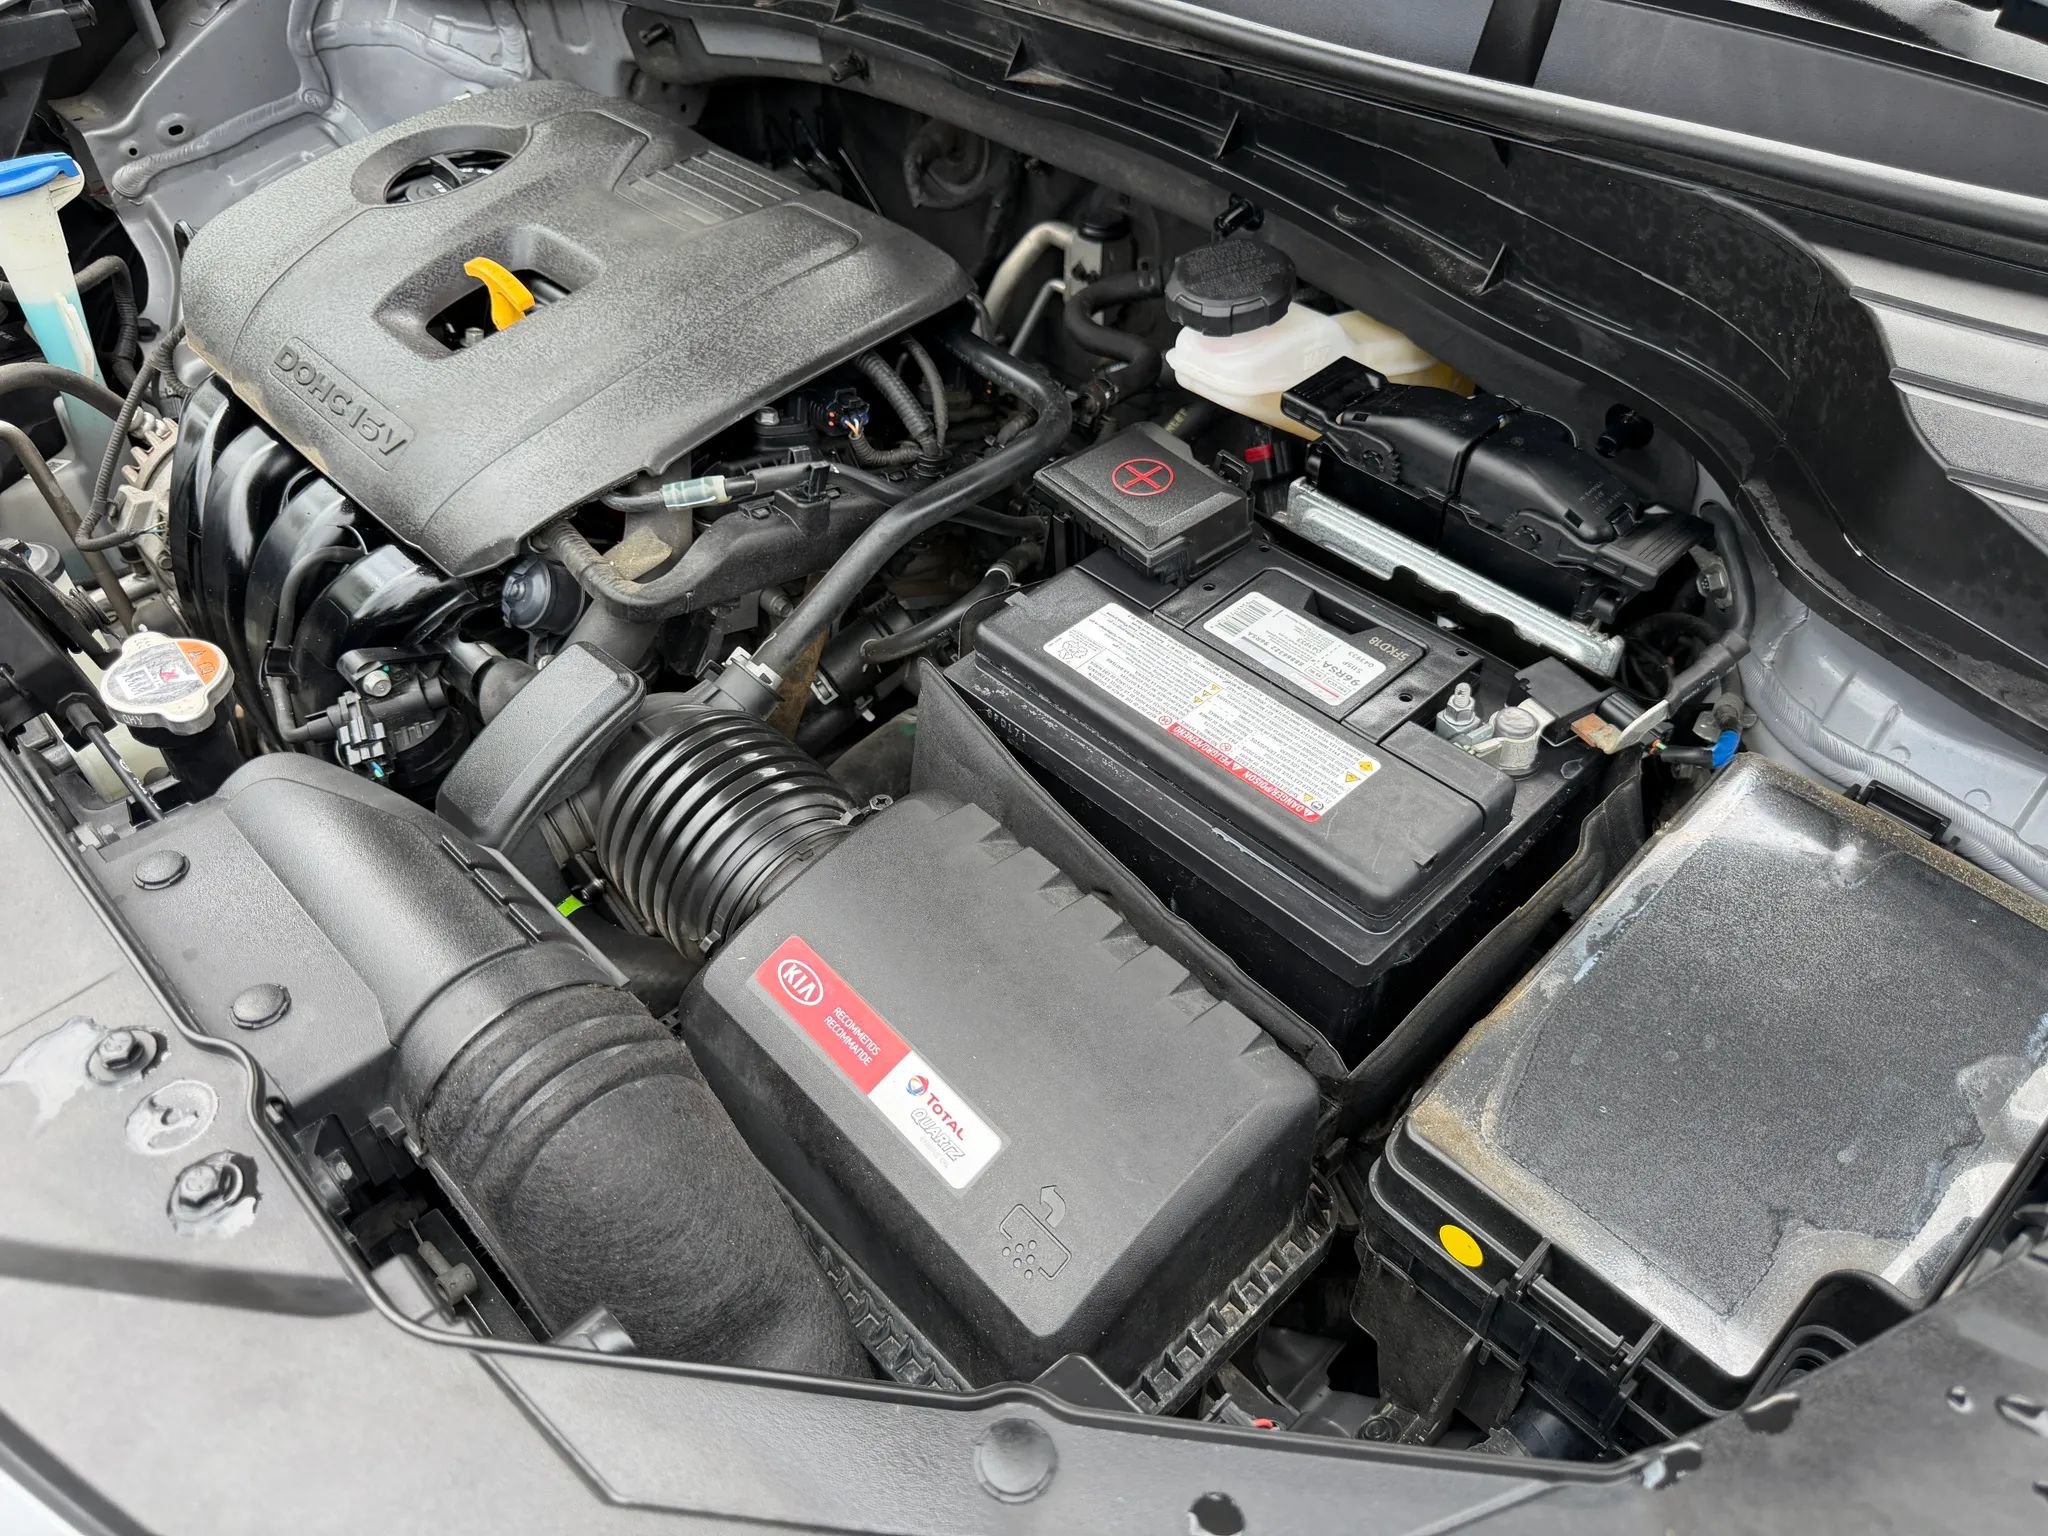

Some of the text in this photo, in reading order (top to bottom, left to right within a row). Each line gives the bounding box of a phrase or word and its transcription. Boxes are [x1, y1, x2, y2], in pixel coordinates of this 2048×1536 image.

[274, 346, 352, 416] DOHC
[1318, 659, 1362, 687] 96RSA
[783, 963, 816, 1001] KIA
[824, 1016, 873, 1066] RECOMMANDE
[833, 1007, 881, 1056] RECOMMENDS
[911, 1108, 966, 1161] QUARTZ
[927, 1092, 964, 1141] TOTAL
